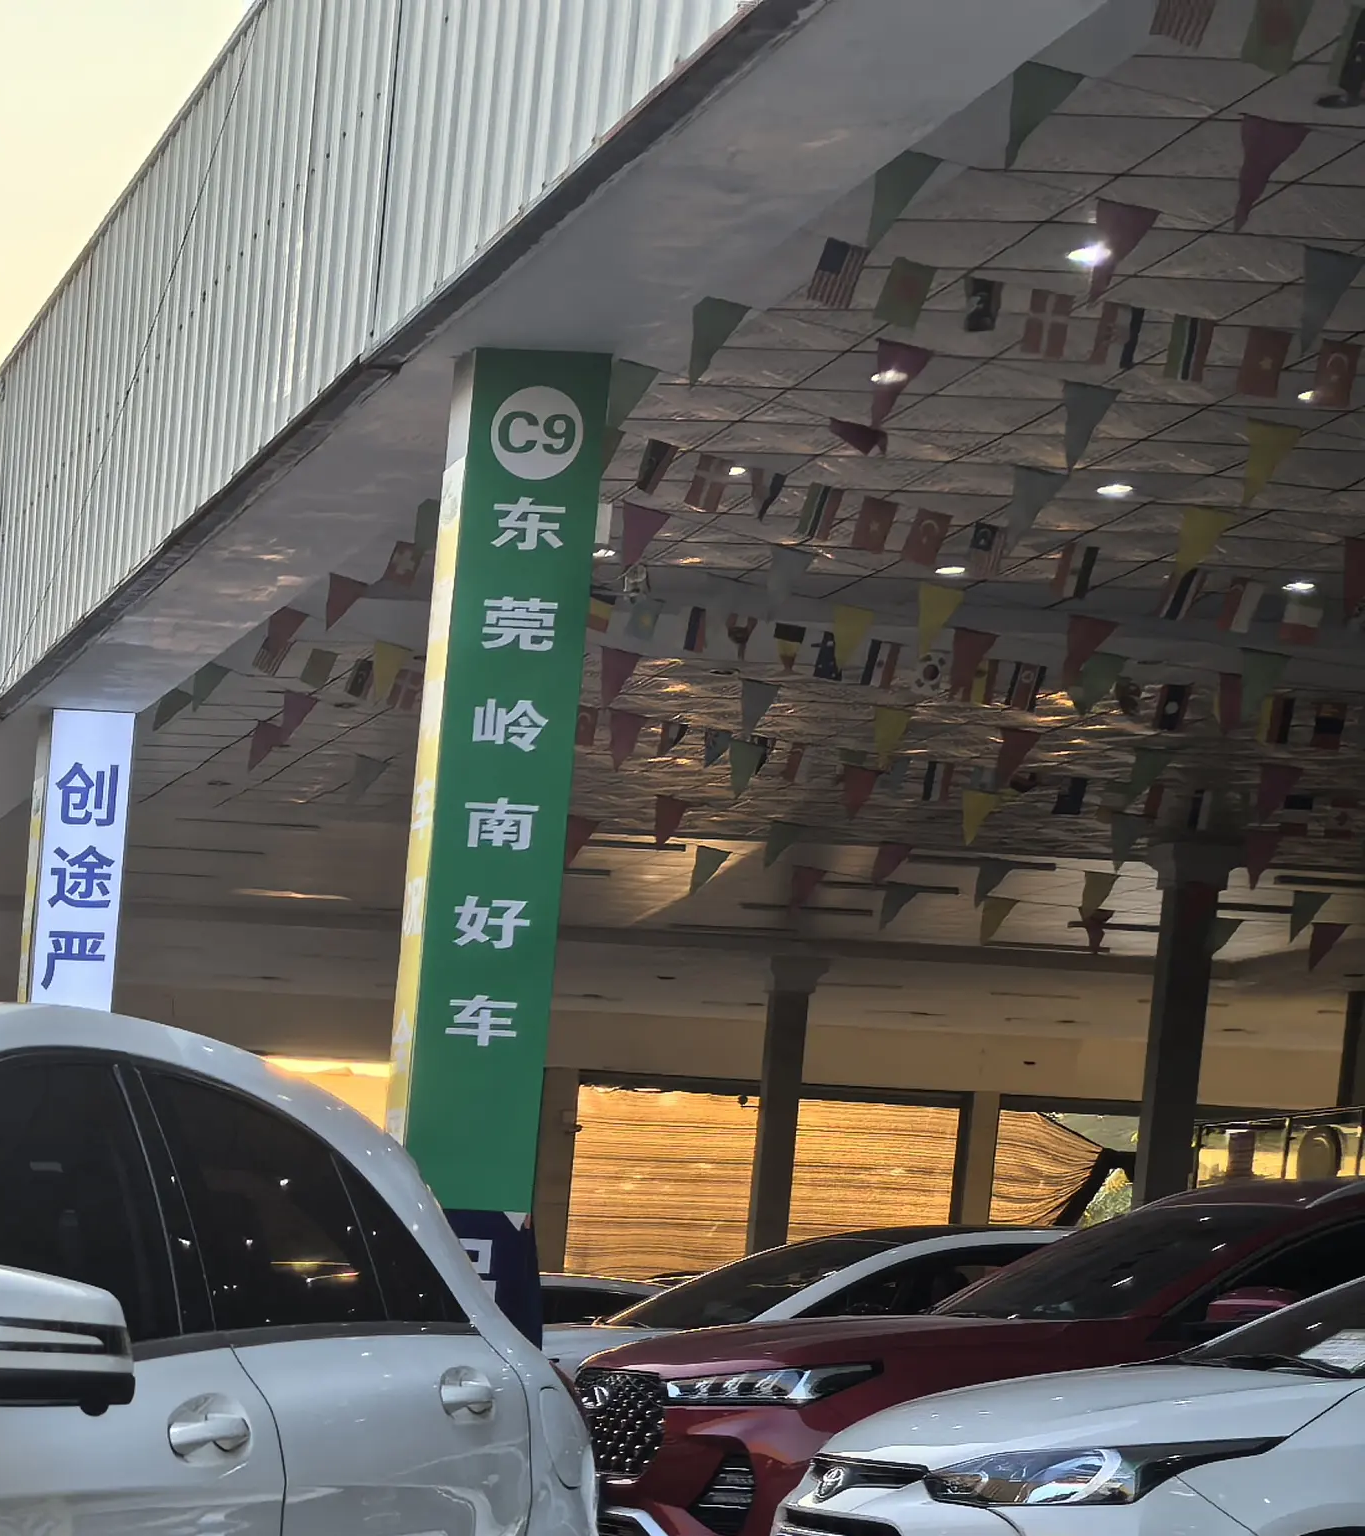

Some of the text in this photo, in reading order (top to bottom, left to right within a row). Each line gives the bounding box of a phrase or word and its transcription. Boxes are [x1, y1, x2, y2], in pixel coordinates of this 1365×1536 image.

[498, 410, 576, 455] C9
[40, 761, 120, 990] 创途严
[445, 496, 567, 1047] 东莞岭南好车
